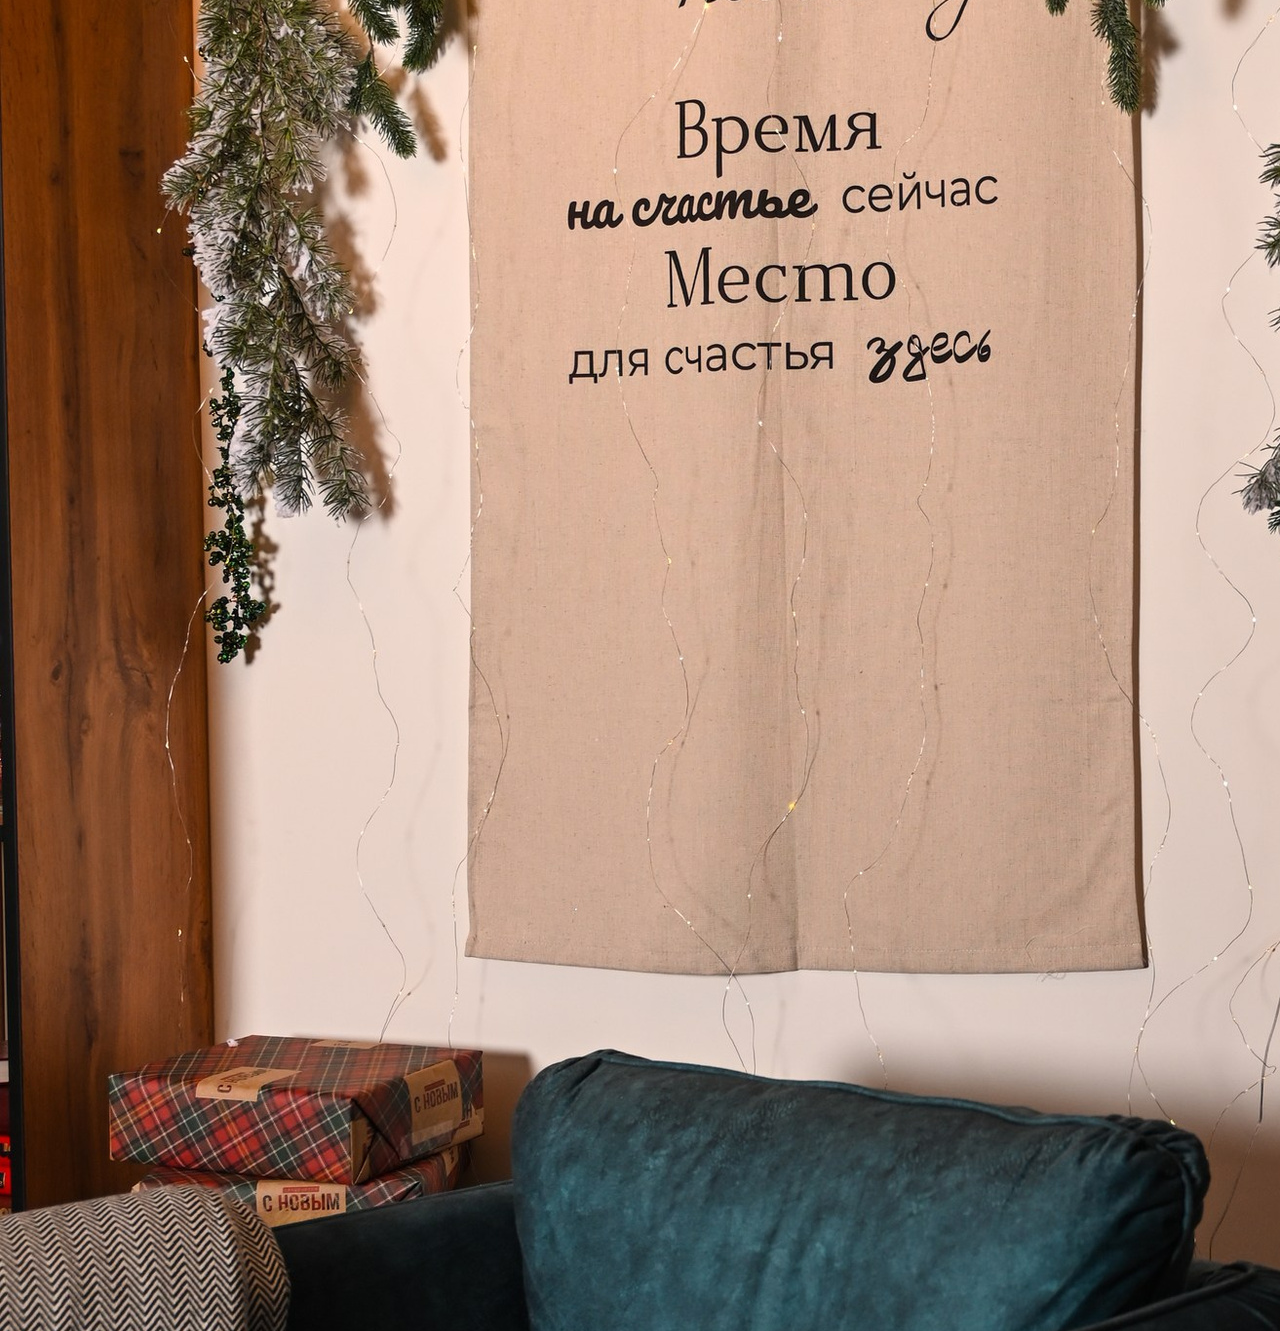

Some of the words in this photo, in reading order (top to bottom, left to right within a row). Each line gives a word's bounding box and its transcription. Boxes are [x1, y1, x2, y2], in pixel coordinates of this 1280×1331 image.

[675, 99, 881, 177] Время
[568, 198, 623, 230] на
[631, 186, 818, 227] счастье
[842, 172, 998, 214] сейчас
[664, 247, 896, 308] Место
[568, 348, 648, 384] для
[664, 340, 834, 375] счастья
[866, 328, 991, 383] здесь
[414, 1097, 421, 1113] С
[423, 1081, 459, 1110] НОВЫМ
[263, 1194, 273, 1212] С
[278, 1192, 341, 1211] НОВЫМ
